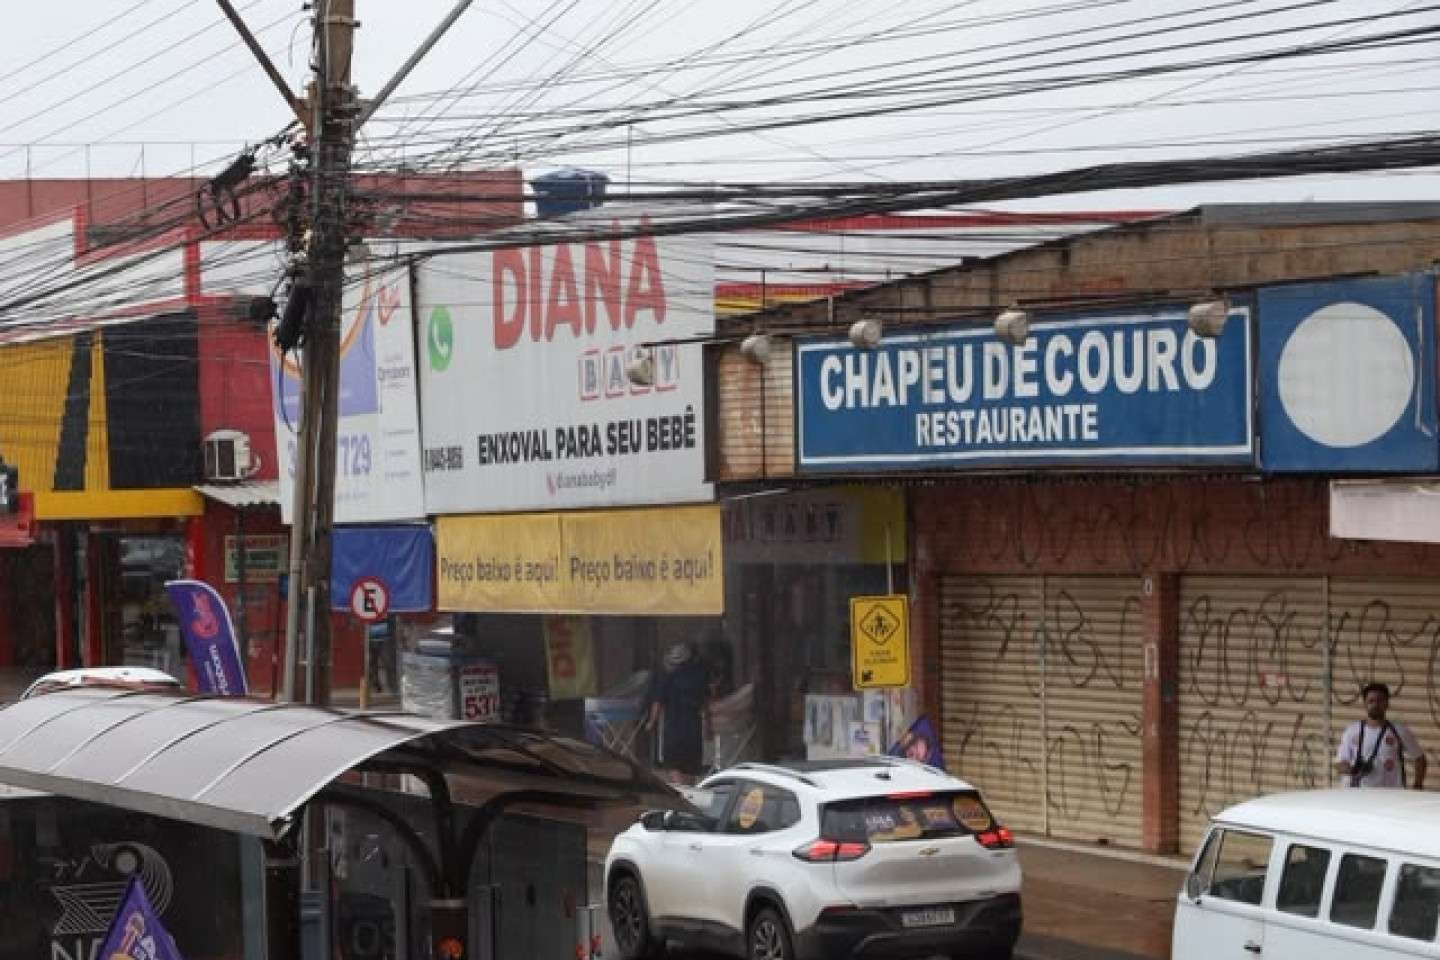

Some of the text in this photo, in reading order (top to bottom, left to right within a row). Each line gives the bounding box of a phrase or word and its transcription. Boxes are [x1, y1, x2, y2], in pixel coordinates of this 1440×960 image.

[492, 214, 667, 350] DIANA
[579, 345, 678, 398] BAY
[819, 329, 1217, 410] CHAPEU DE COURO
[478, 428, 553, 466] ENXOVAL
[555, 423, 604, 460] PARA
[606, 418, 642, 456] SEU
[646, 404, 696, 452] BEBÊ
[915, 403, 1099, 447] RESTAURANTE
[440, 556, 474, 588] Preço
[476, 554, 512, 582] baixo
[570, 556, 610, 589] Preço
[613, 554, 656, 581] baixo
